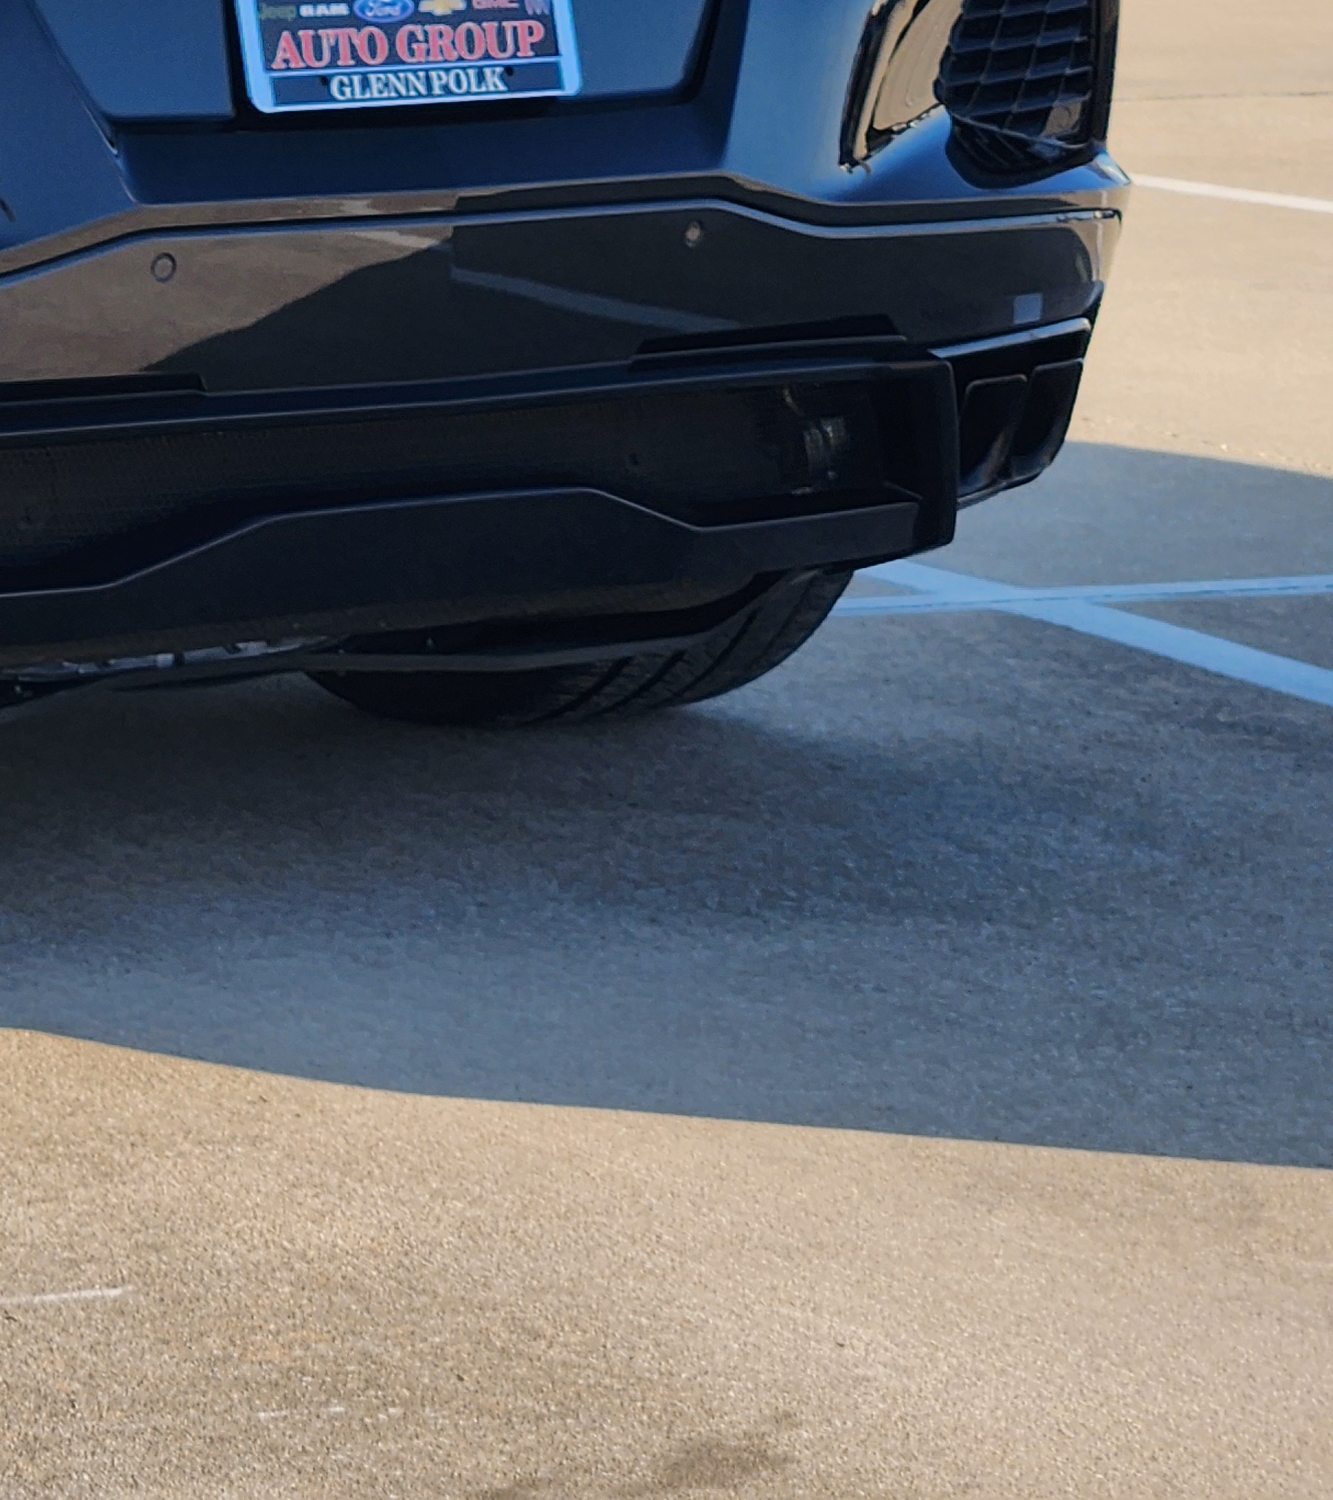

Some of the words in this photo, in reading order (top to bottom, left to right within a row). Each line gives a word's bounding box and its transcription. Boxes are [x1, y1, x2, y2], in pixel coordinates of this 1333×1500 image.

[365, 0, 402, 18] Ford
[271, 27, 388, 70] AUTO
[395, 20, 545, 66] GROUP
[331, 72, 431, 101] GLENN
[432, 65, 508, 96] POLK
